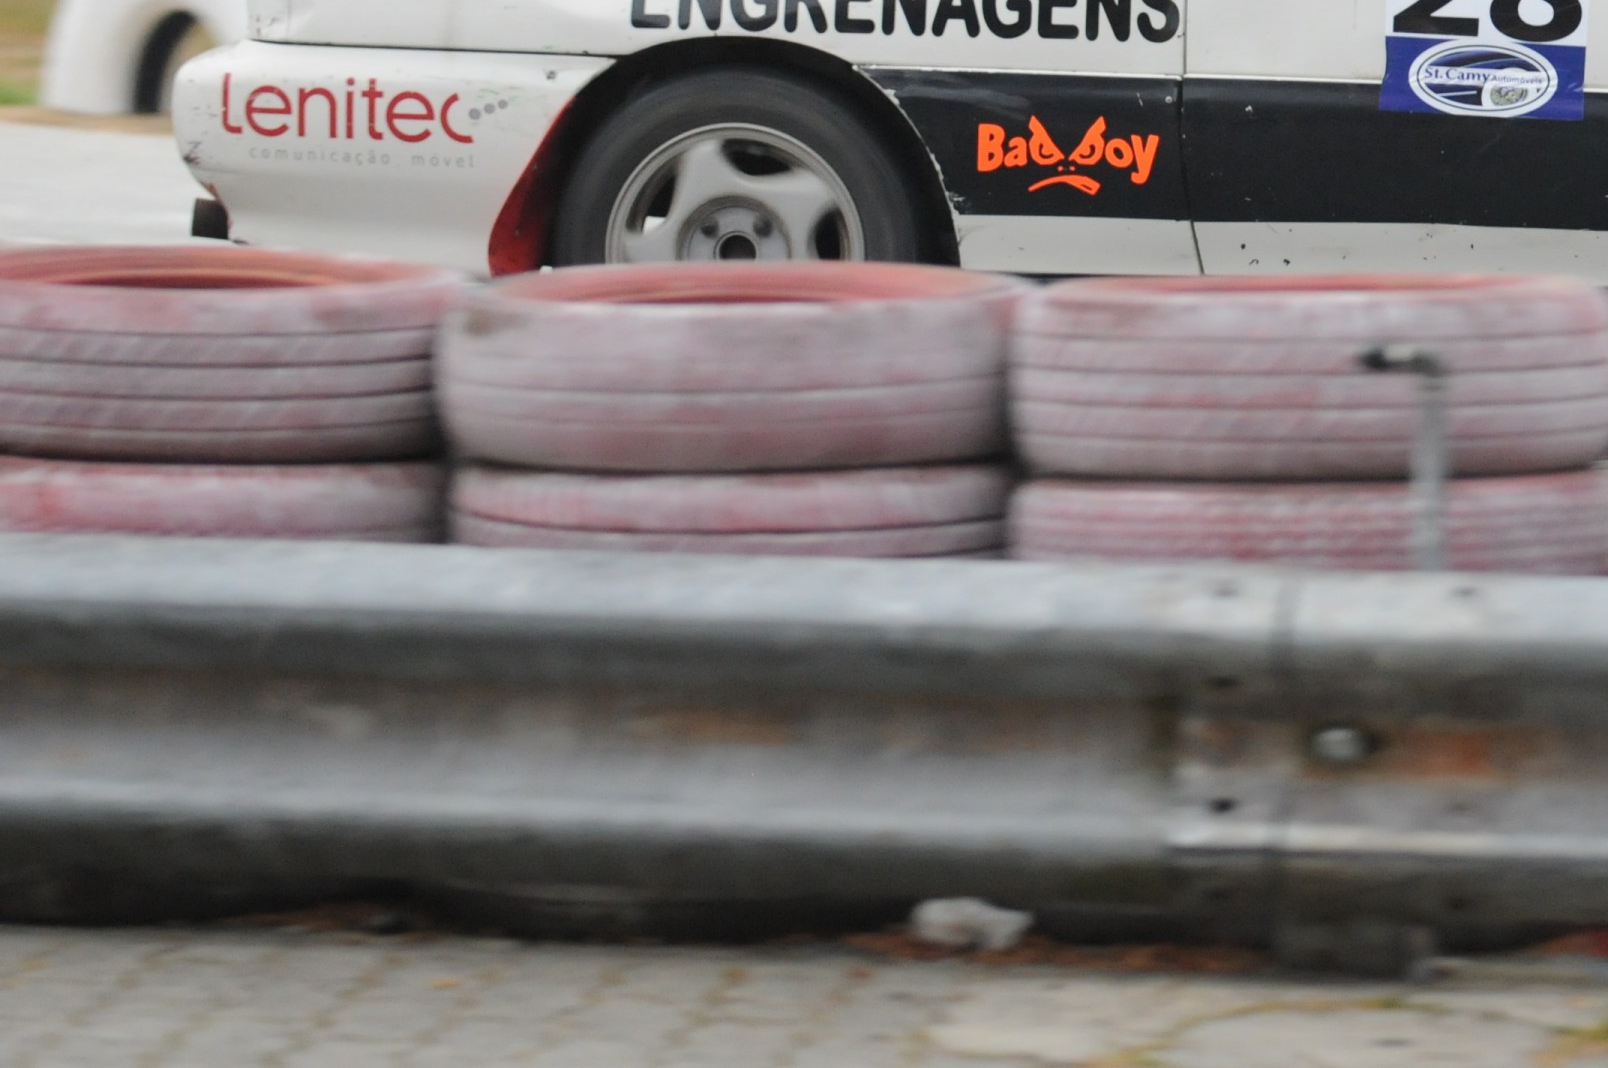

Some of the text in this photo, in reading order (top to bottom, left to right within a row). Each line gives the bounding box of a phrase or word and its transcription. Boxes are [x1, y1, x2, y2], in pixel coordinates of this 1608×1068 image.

[1424, 67, 1443, 80] St.
[1445, 68, 1491, 82] Camy
[249, 146, 475, 168] comunicação móvel
